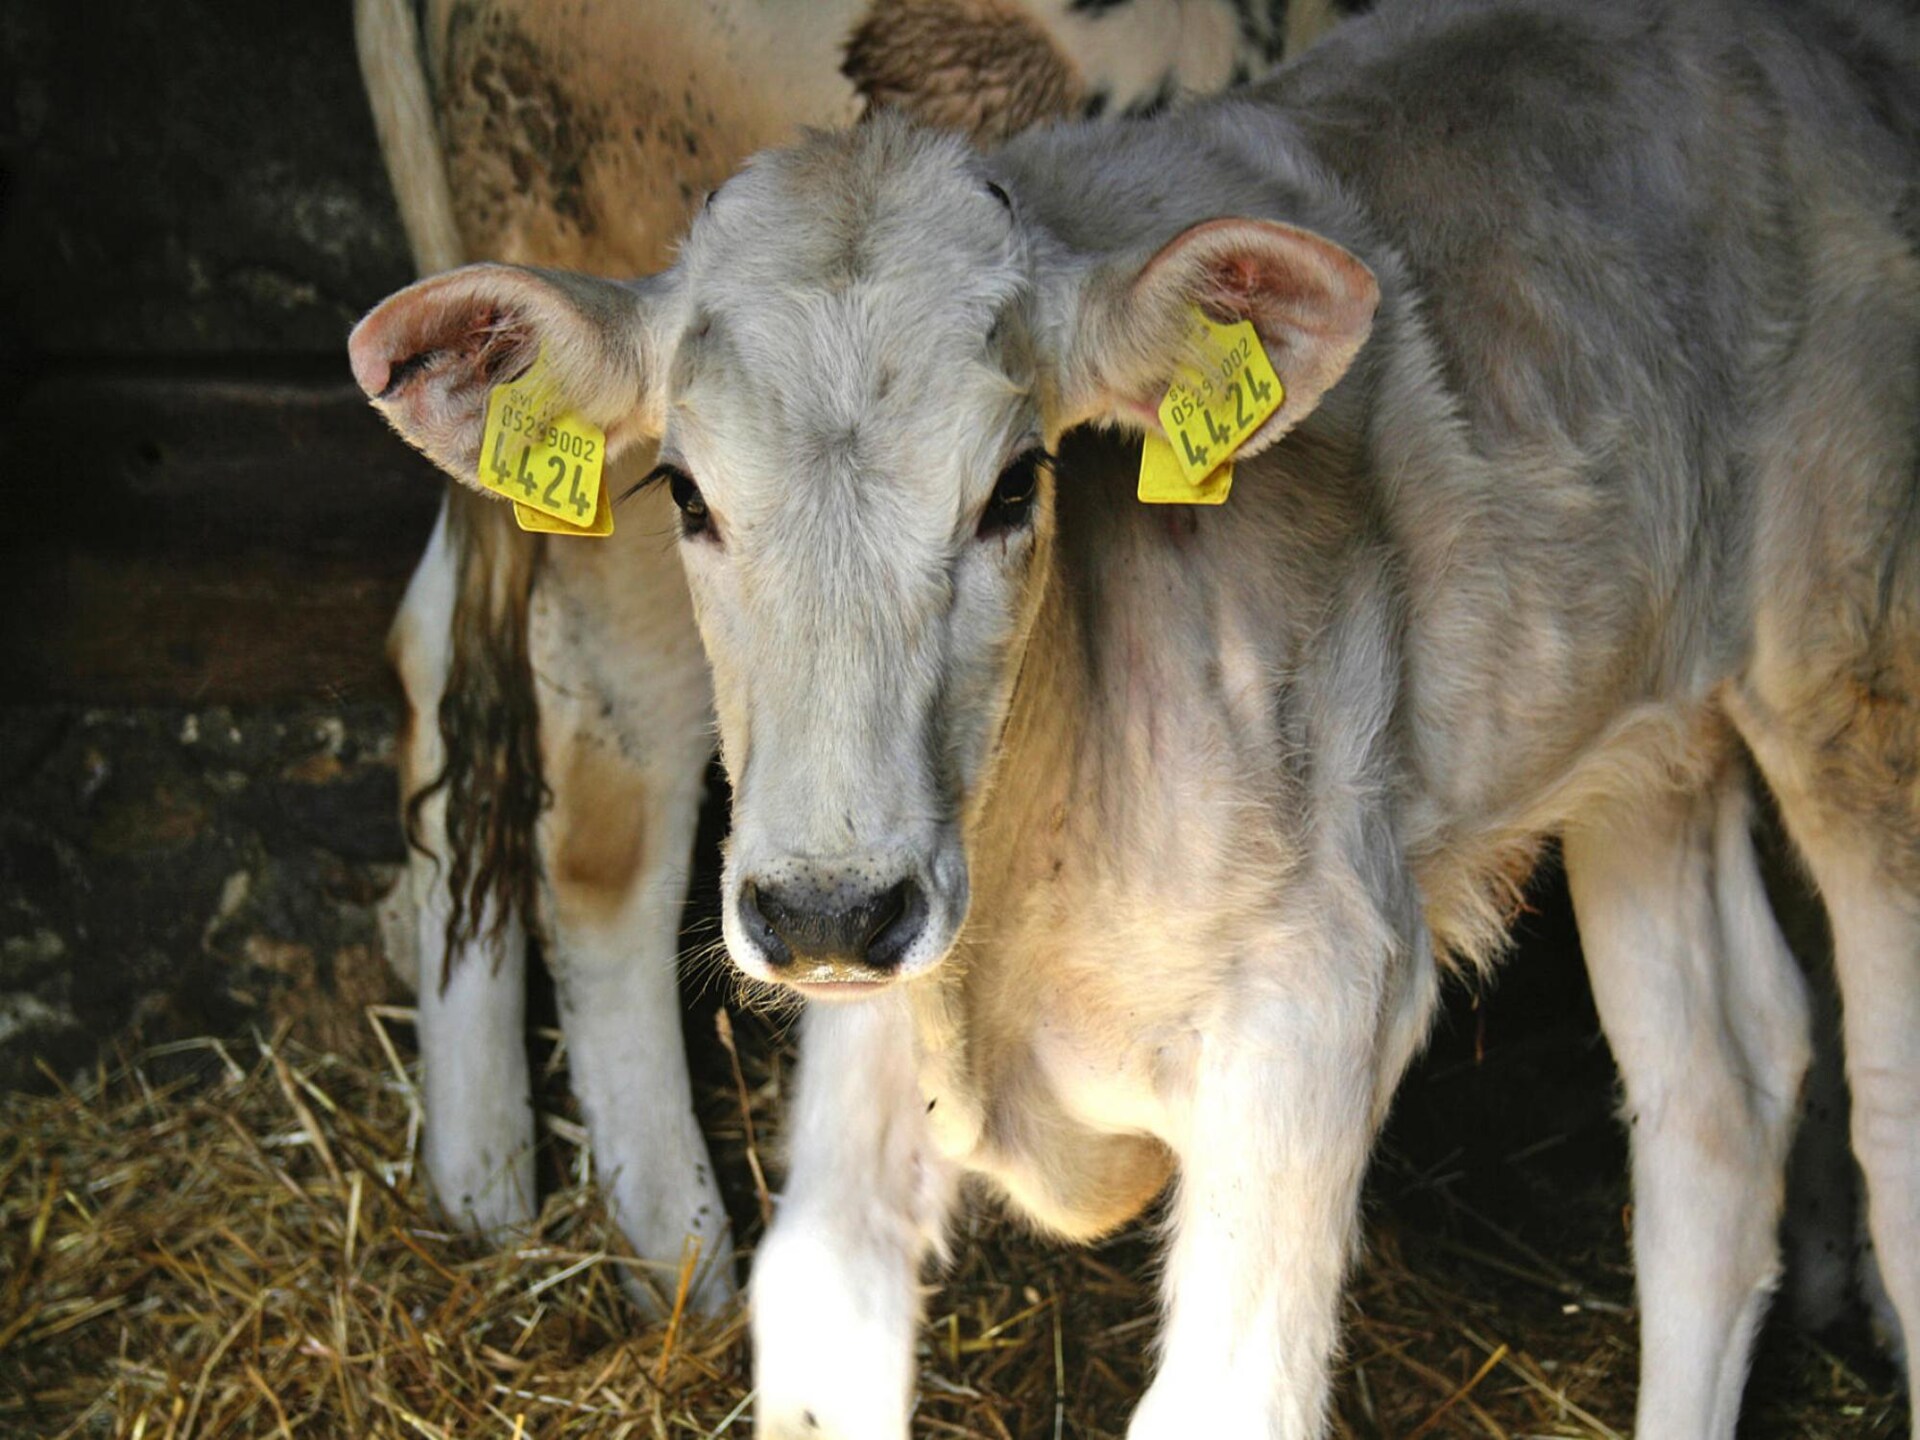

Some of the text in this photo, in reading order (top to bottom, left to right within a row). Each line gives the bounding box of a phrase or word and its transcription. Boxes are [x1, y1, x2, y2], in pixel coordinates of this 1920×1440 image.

[1171, 337, 1252, 426] 0529002
[1180, 366, 1272, 467] 4424
[490, 431, 591, 517] 4424
